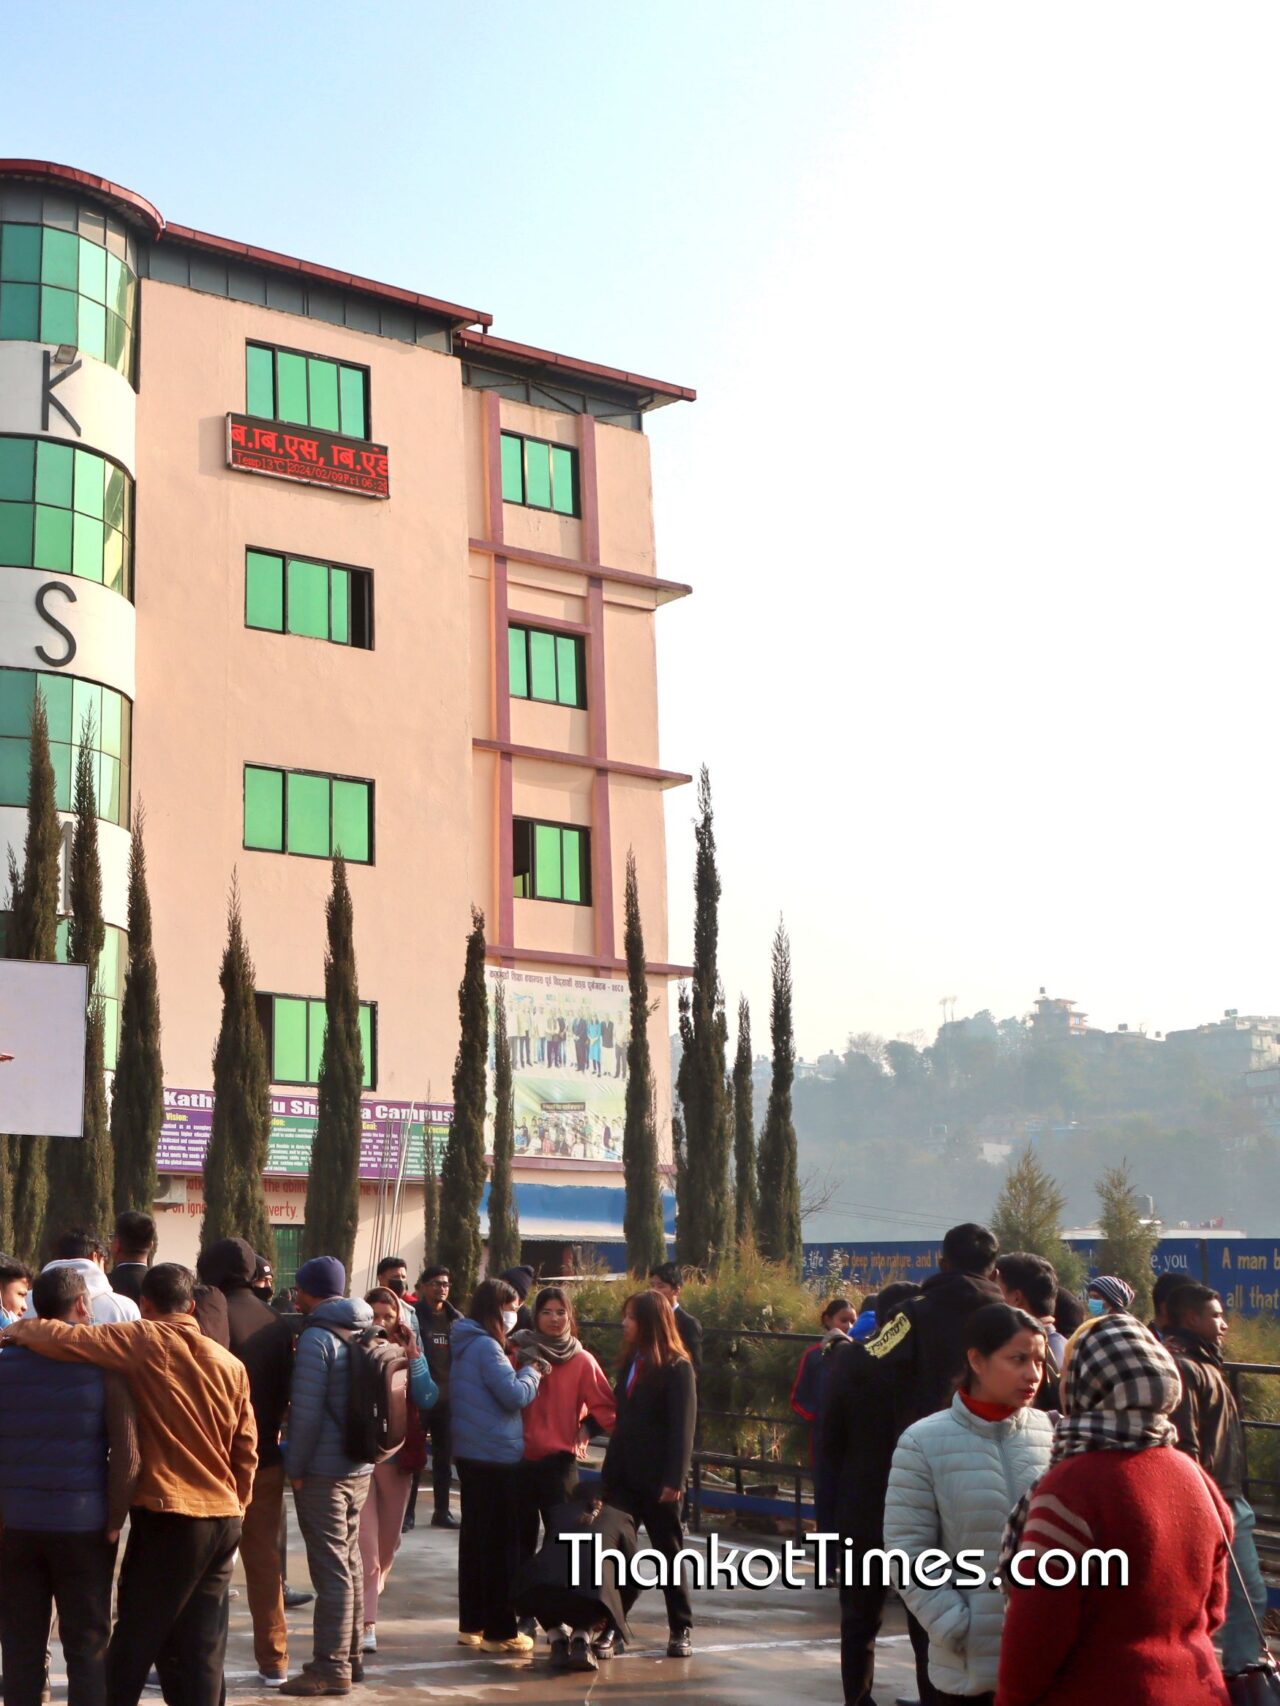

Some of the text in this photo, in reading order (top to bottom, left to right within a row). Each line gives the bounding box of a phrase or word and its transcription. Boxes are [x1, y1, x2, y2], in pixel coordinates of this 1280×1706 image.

[41, 350, 82, 437] K
[35, 581, 77, 667] S
[282, 1177, 307, 1193] abilit
[1164, 1254, 1188, 1272] you
[1222, 1248, 1231, 1269] A
[1237, 1256, 1267, 1270] man
[1226, 1284, 1244, 1310] all
